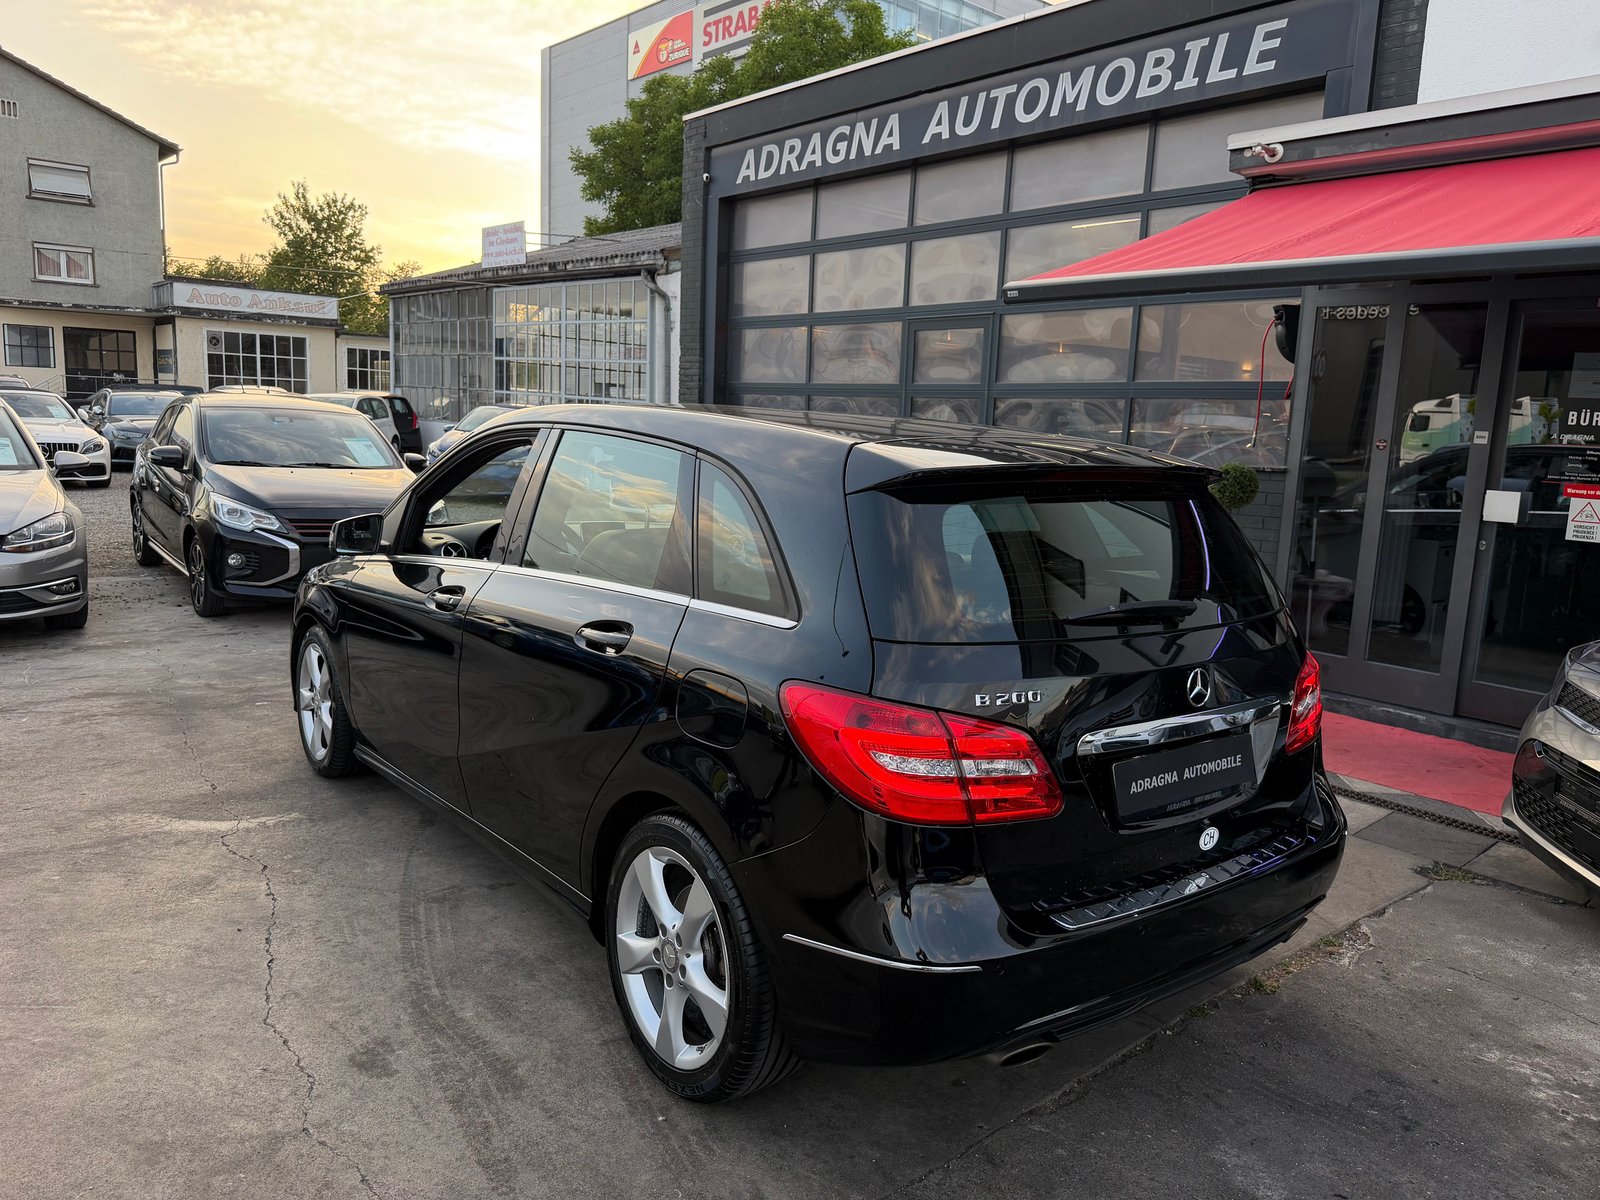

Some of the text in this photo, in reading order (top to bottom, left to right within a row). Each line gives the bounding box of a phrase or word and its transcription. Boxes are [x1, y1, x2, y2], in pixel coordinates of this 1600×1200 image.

[702, 0, 772, 47] STRAB
[735, 17, 1288, 185] ADRAGNA AUTOMOBILE
[187, 287, 326, 315] Auto Ankauf
[975, 690, 1041, 707] B 200
[1130, 754, 1242, 795] ADRAGNA AUTOMOBILE
[1203, 831, 1215, 847] CH
